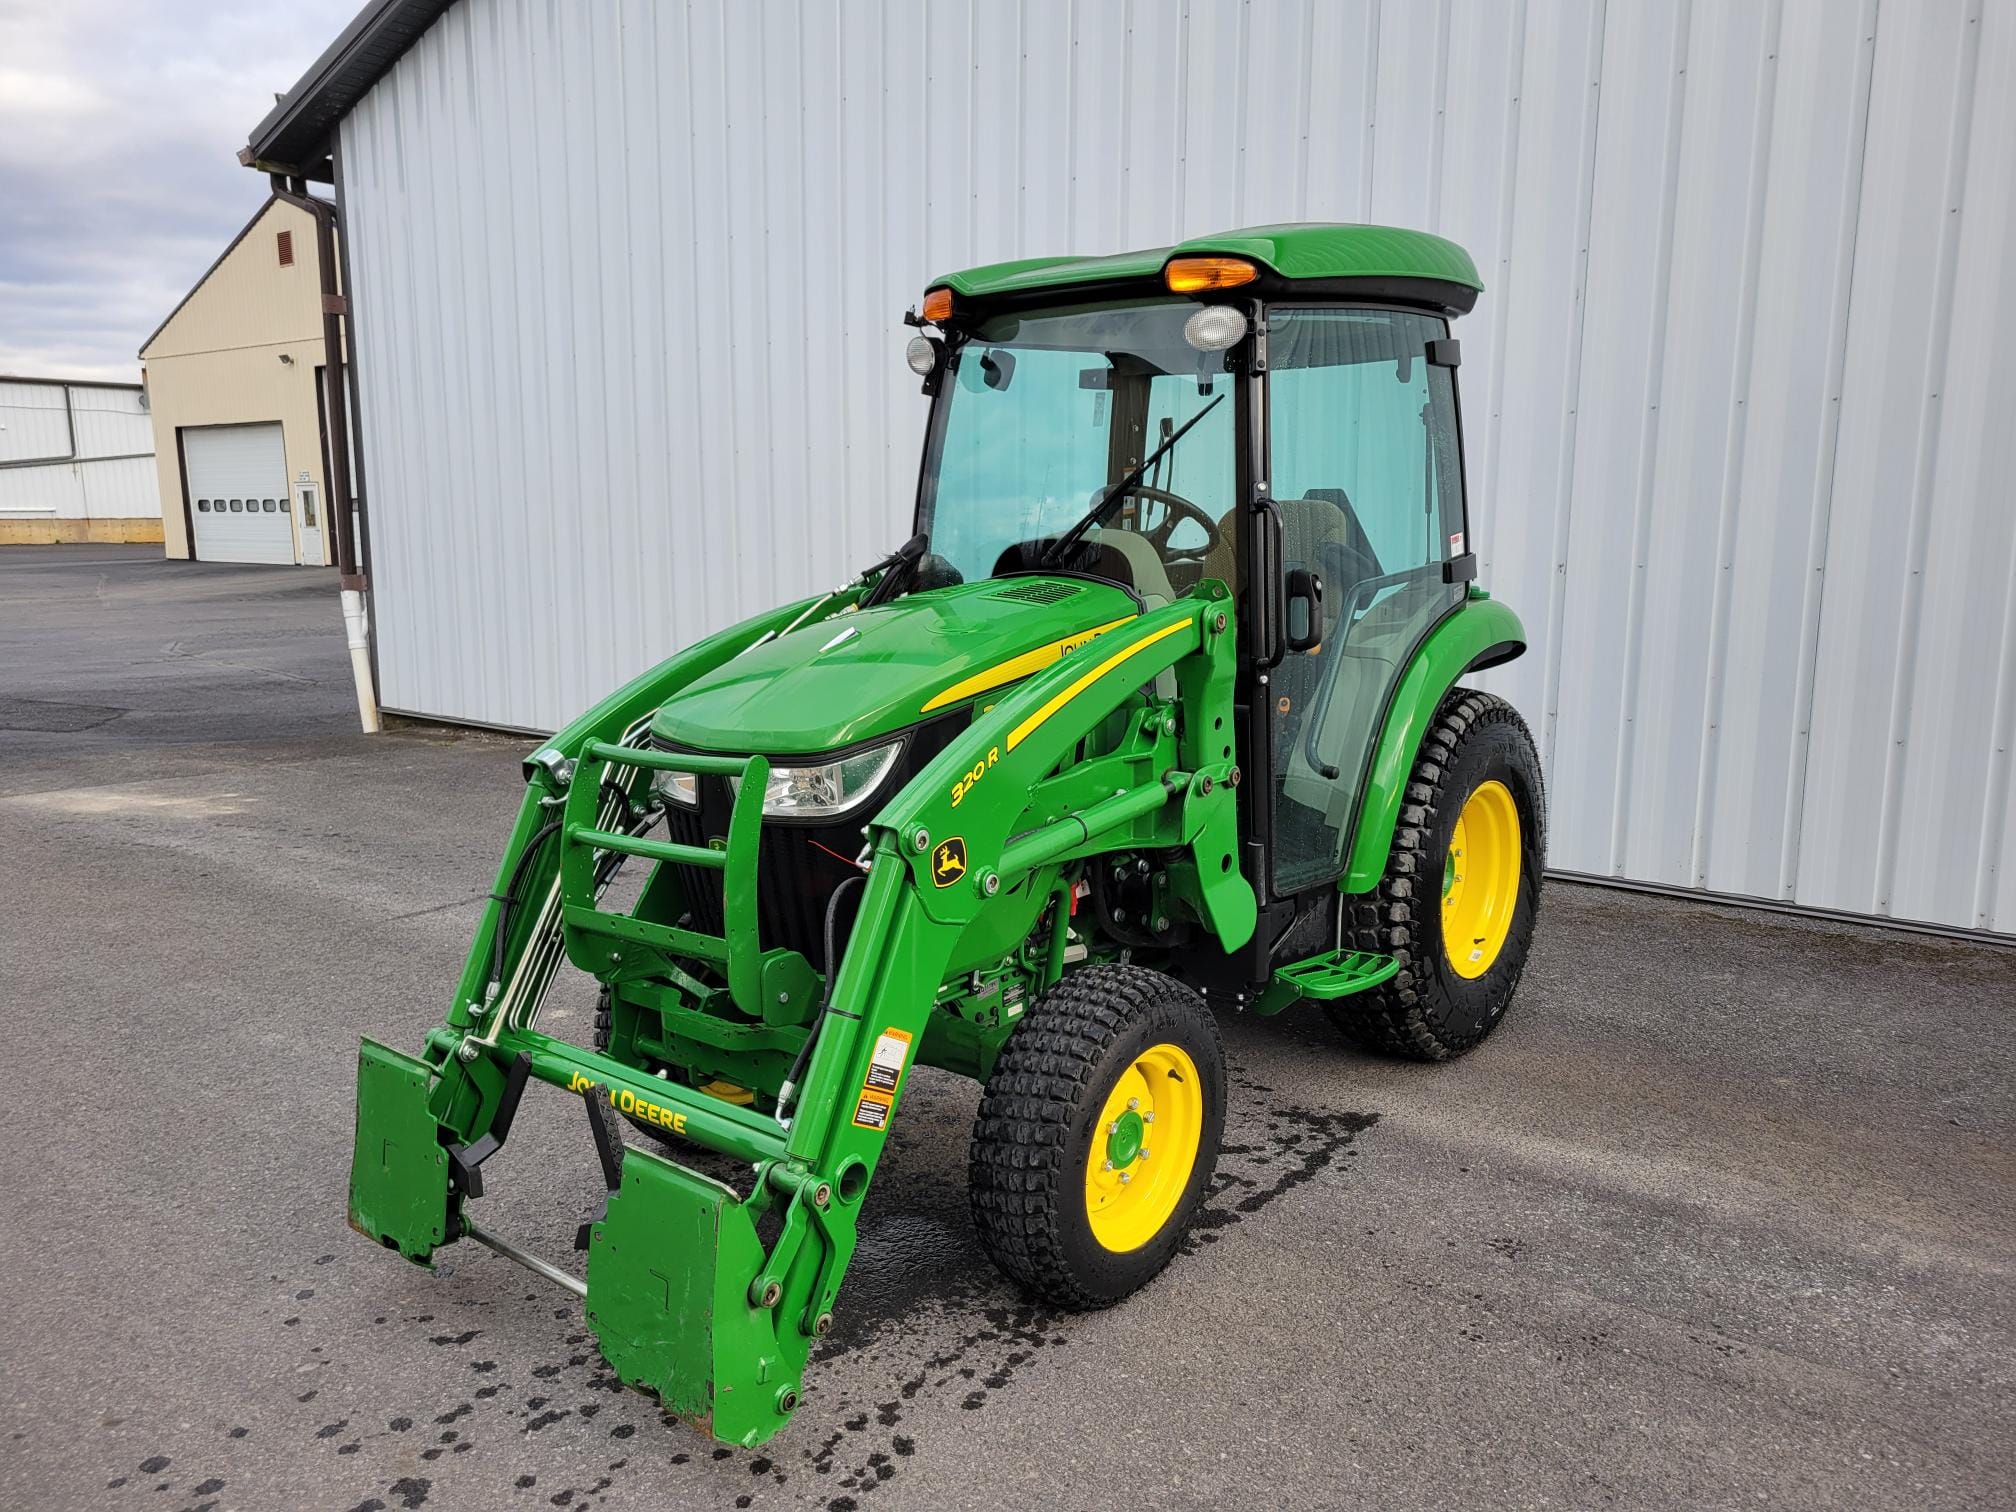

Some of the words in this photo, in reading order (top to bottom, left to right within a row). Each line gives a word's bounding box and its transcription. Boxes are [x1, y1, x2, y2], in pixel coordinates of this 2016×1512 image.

[951, 760, 985, 808] 320
[988, 746, 998, 769] R
[620, 1089, 688, 1135] DEERE
